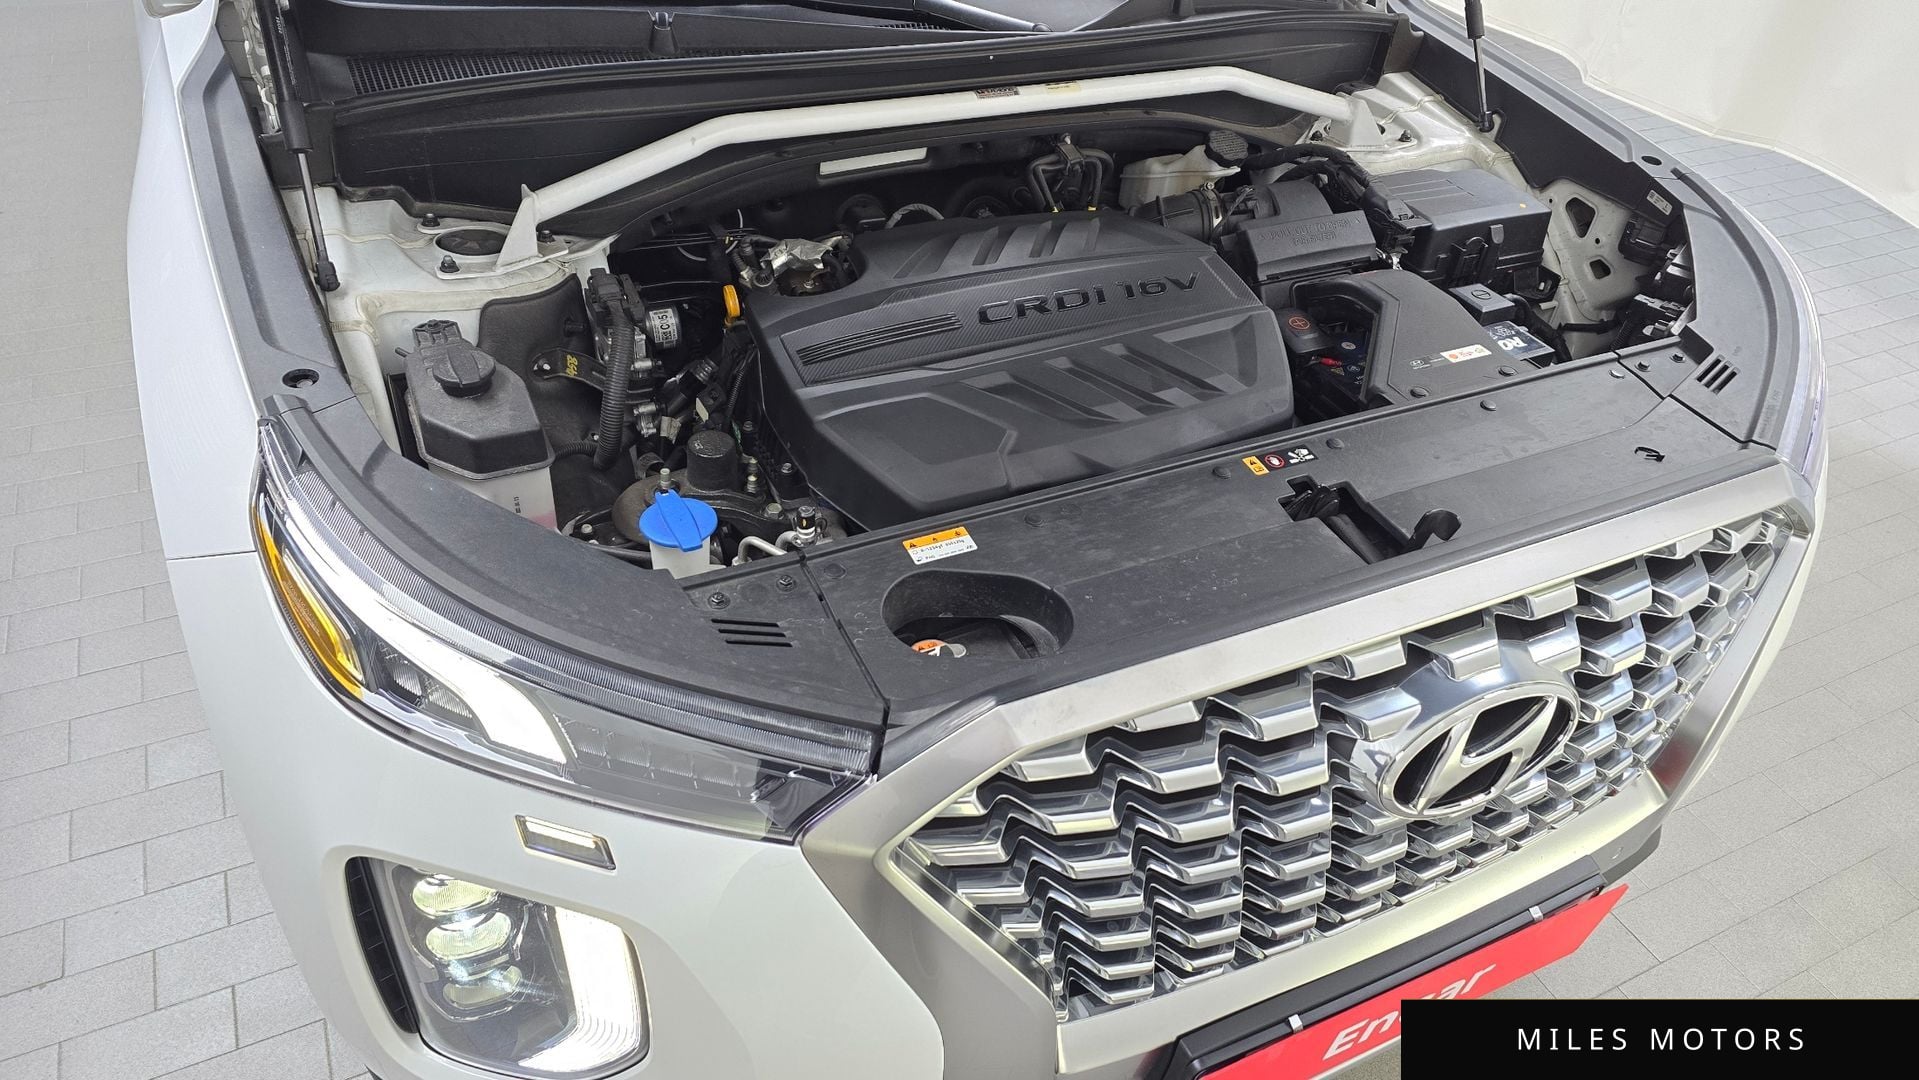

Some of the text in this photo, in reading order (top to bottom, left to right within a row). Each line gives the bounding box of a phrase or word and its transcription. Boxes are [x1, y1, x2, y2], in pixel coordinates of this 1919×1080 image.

[977, 271, 1200, 326] CRDI 16V
[1322, 963, 1496, 1061] Enar
